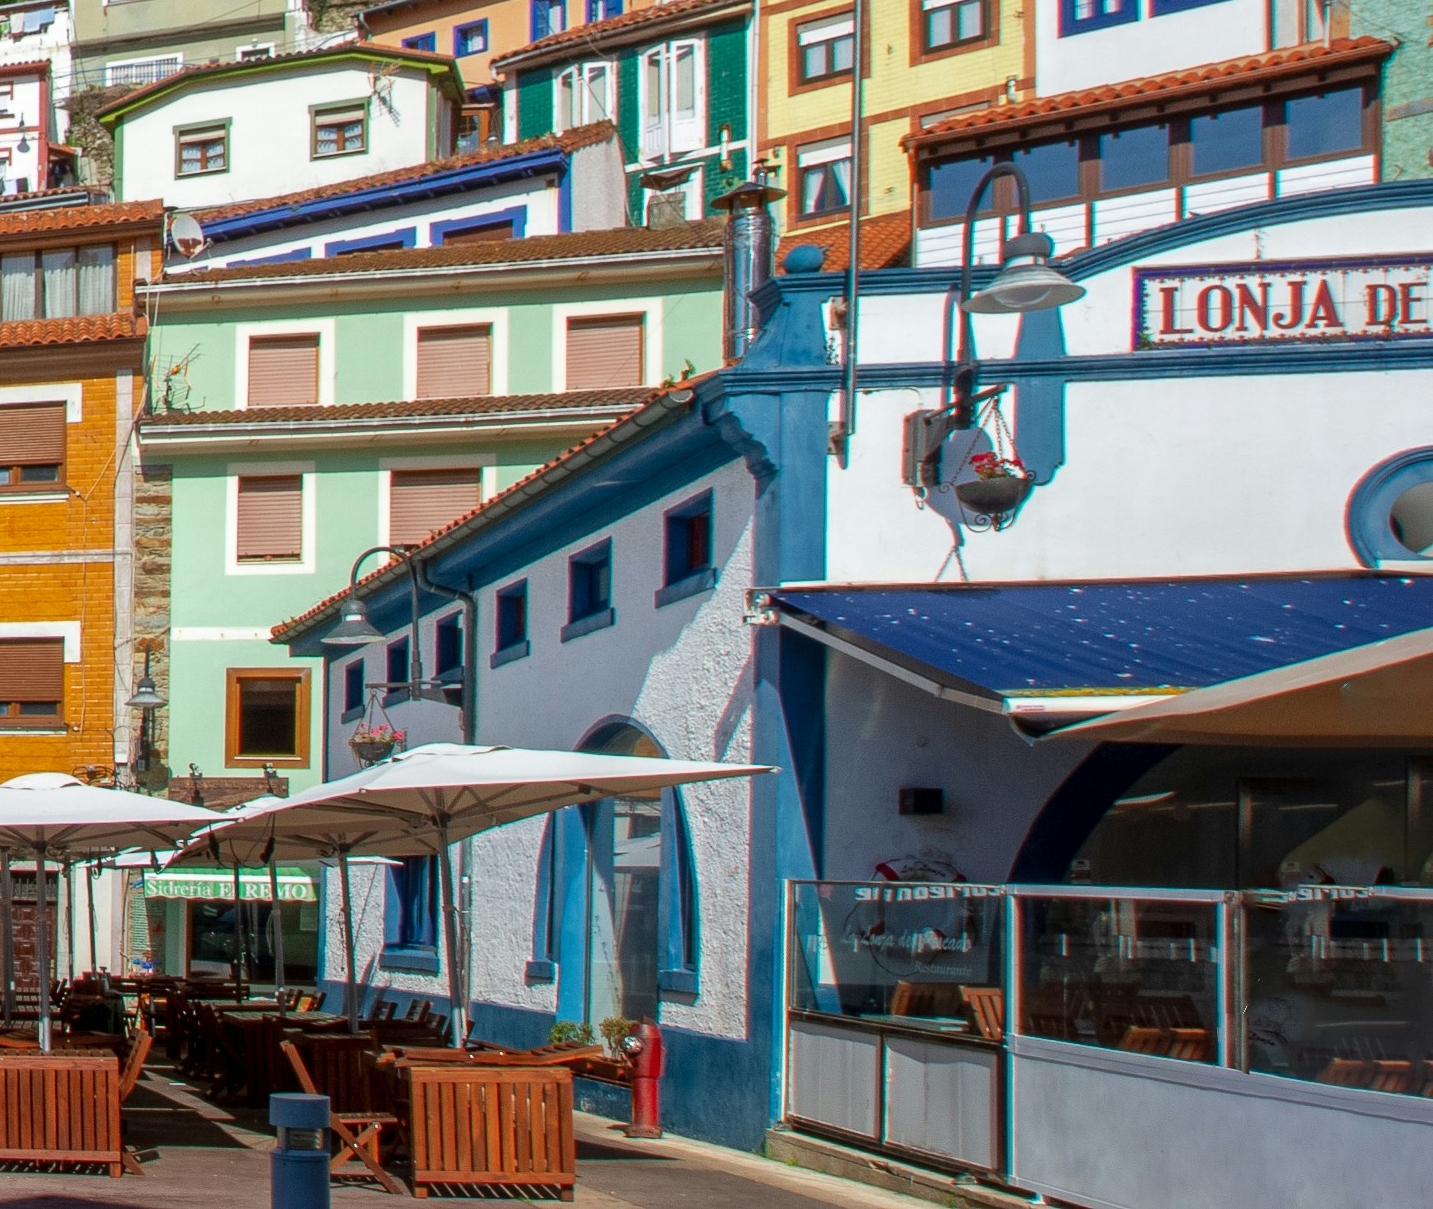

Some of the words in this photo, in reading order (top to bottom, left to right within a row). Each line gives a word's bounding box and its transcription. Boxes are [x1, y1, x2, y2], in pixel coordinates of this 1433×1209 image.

[1159, 278, 1343, 335] LONJA
[1365, 281, 1428, 327] DE
[146, 880, 212, 897] Sidrería
[218, 882, 235, 898] E
